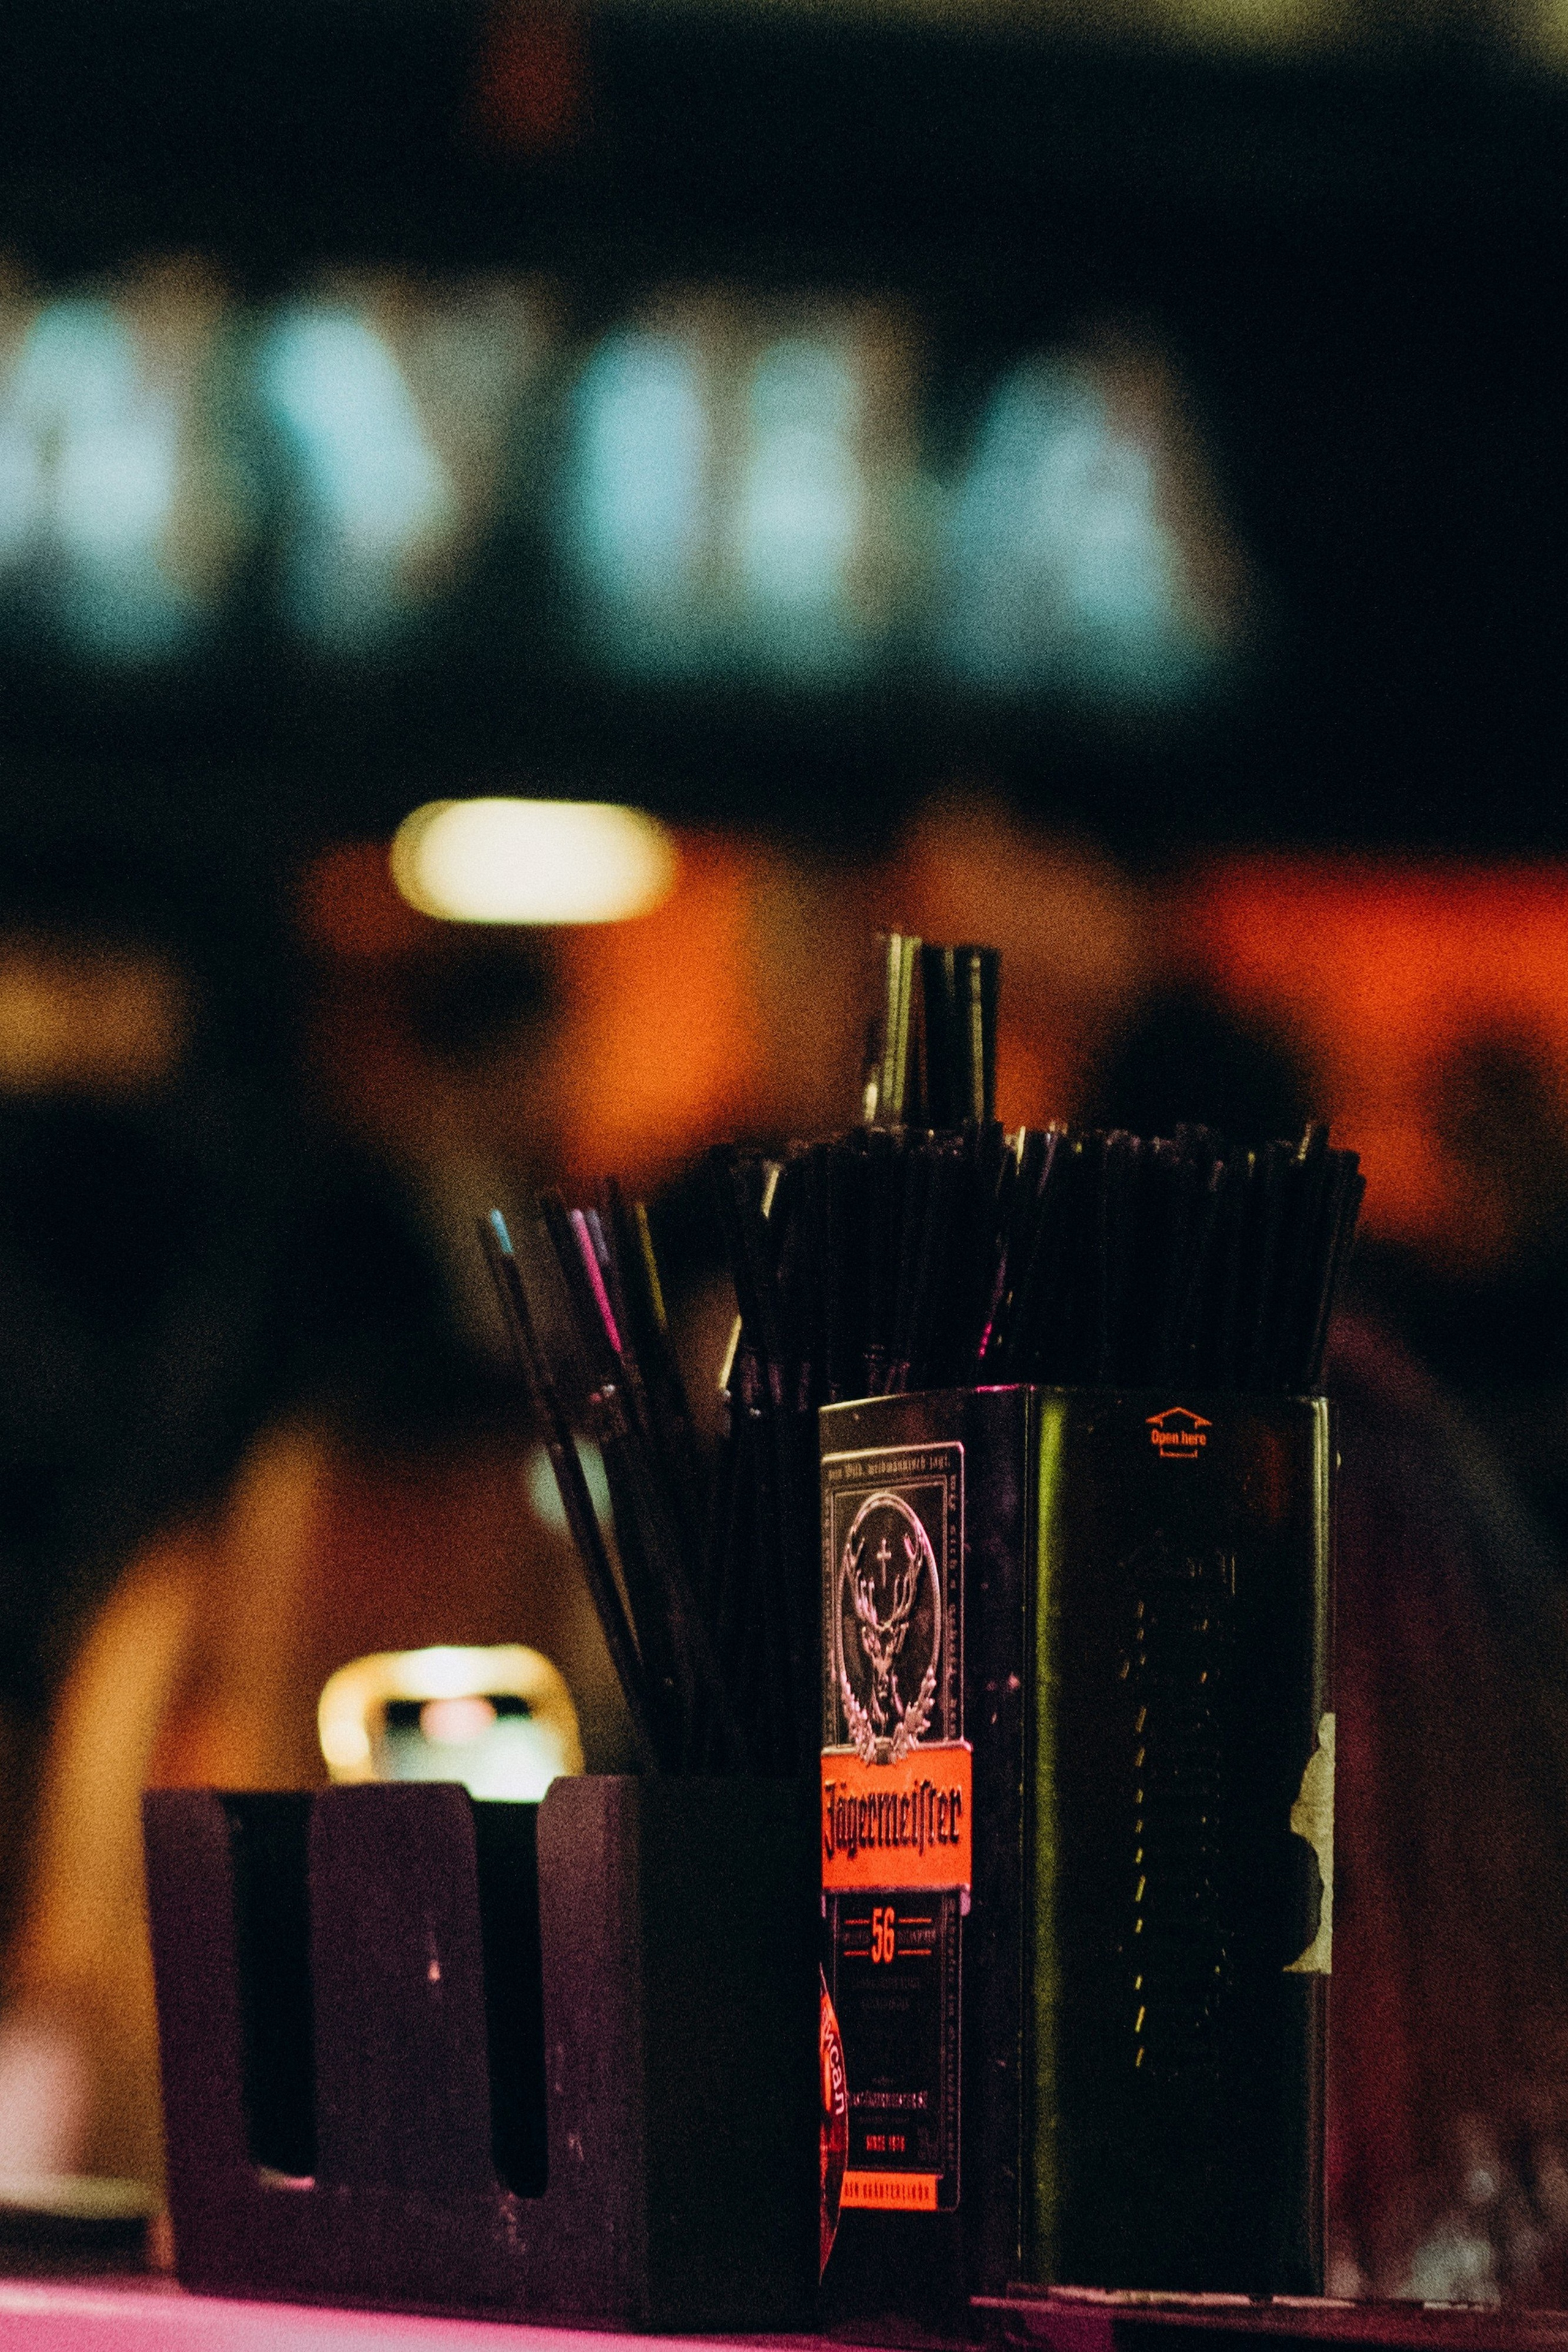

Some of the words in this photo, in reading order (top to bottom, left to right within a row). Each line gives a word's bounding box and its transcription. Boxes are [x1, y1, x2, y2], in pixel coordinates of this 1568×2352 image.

[1151, 1428, 1178, 1447] Open
[1181, 1430, 1207, 1446] here
[871, 1906, 895, 1964] 56
